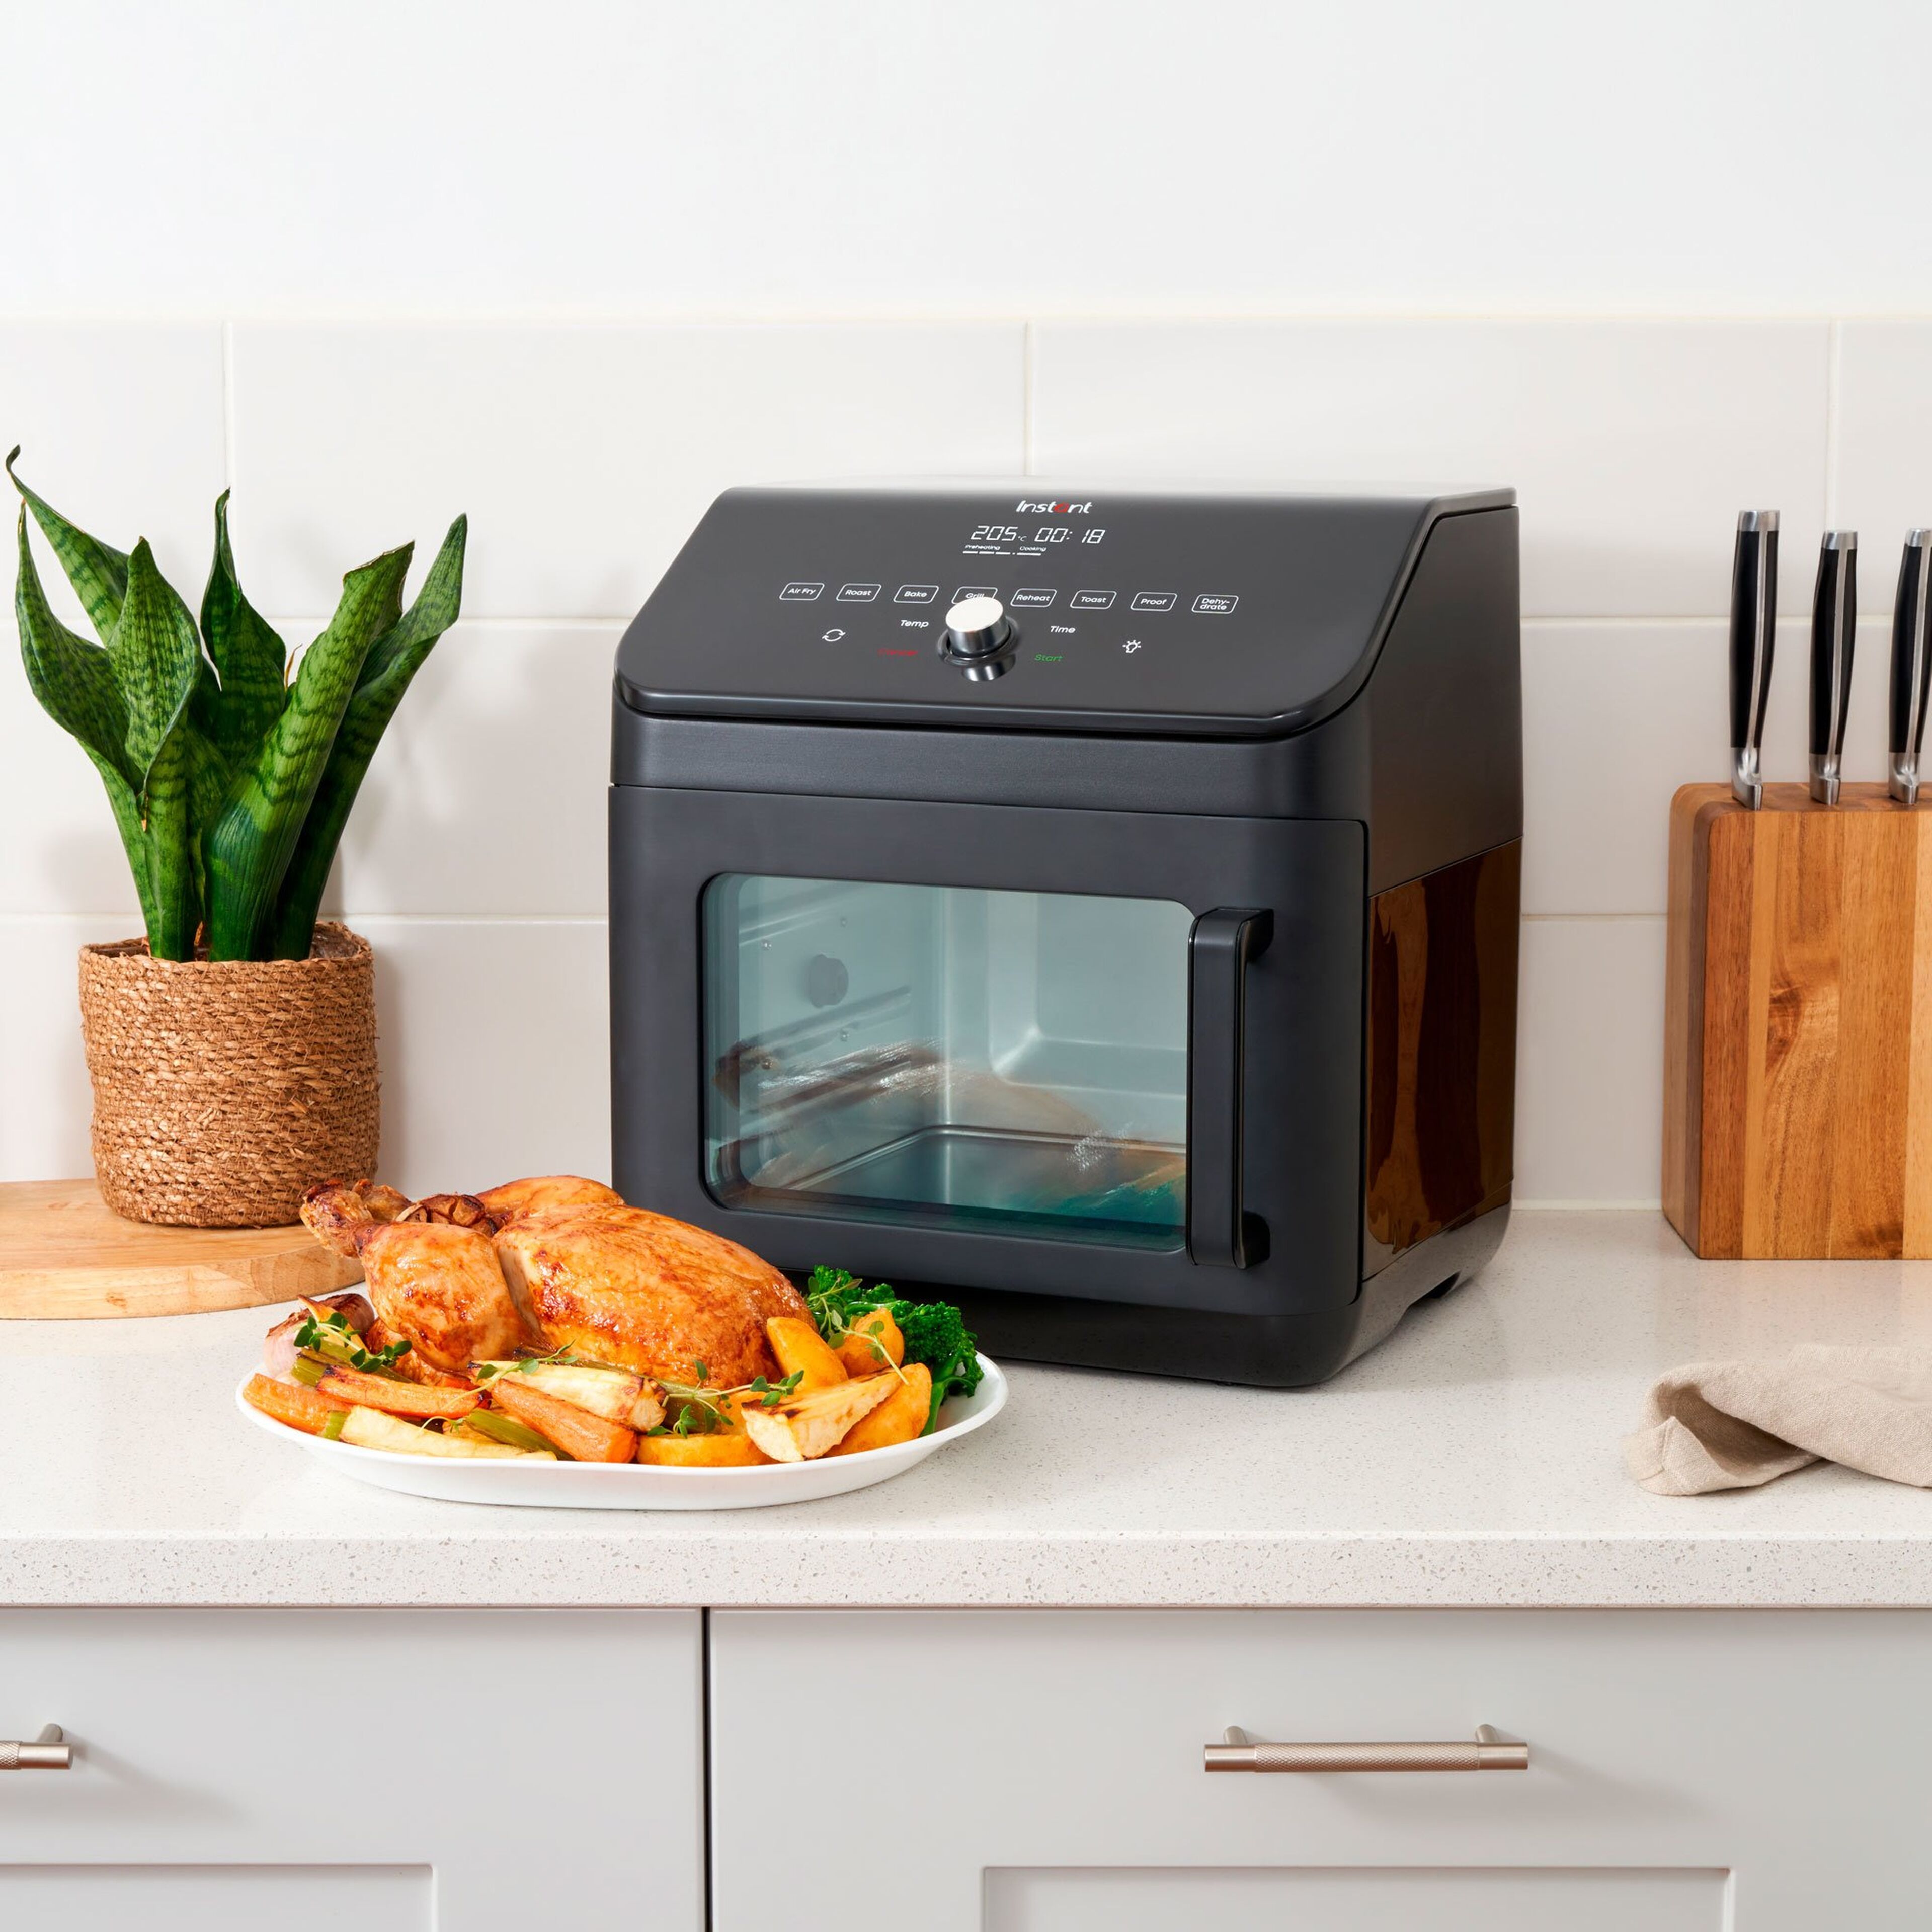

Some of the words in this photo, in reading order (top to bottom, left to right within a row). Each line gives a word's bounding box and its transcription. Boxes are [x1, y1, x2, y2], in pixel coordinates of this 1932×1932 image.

[1016, 500, 1092, 513] Instant
[900, 619, 929, 628] Temp
[1050, 625, 1076, 633] Time
